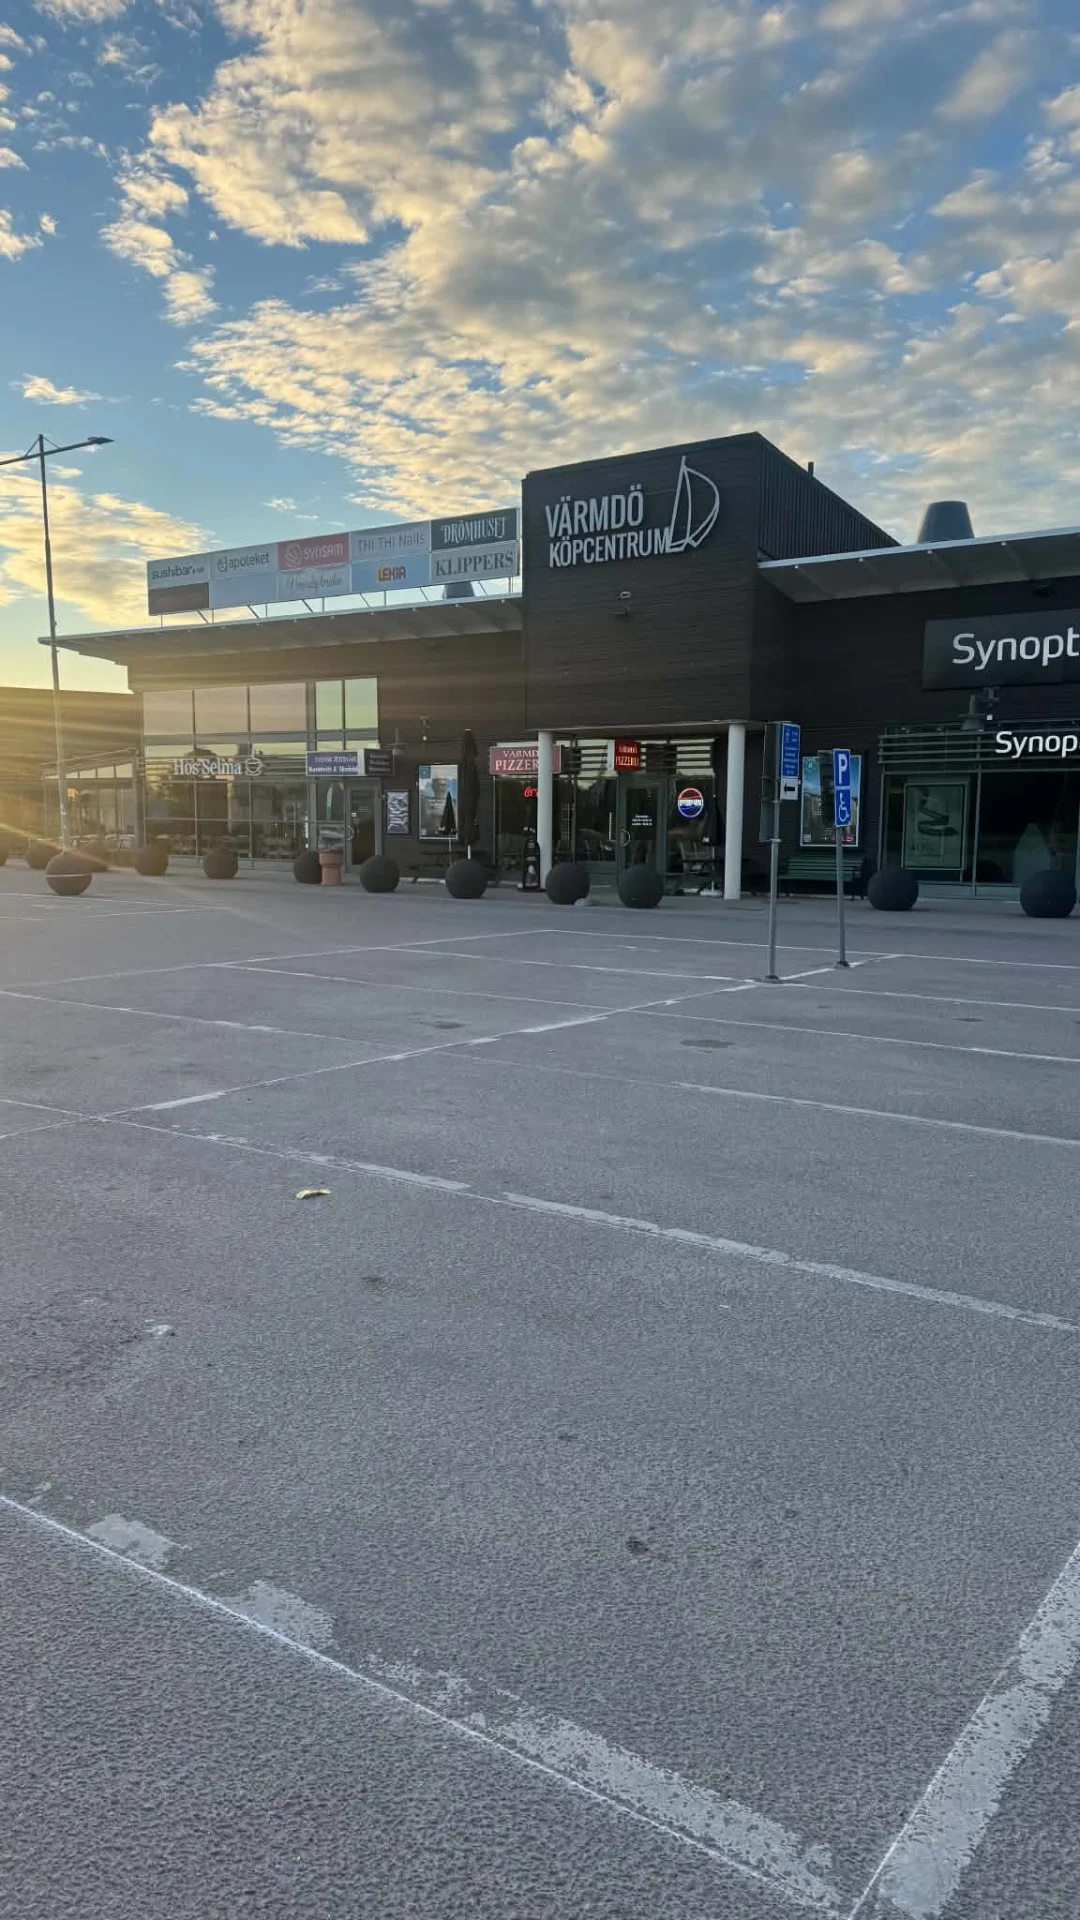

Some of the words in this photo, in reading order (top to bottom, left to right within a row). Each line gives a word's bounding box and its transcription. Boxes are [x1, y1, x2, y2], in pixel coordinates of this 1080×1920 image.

[545, 484, 644, 538] VÄRMDÖ
[399, 532, 425, 547] Nails
[441, 517, 507, 543] DRÖMHUSET
[550, 526, 671, 568] KÖPCENTRUM
[229, 552, 270, 570] apoteket
[435, 550, 514, 577] KLIPPERS
[952, 627, 1080, 671] Synopt
[174, 758, 200, 775] Hos
[201, 757, 242, 775] Selma
[495, 759, 540, 771] PIZZER
[838, 753, 848, 784] P
